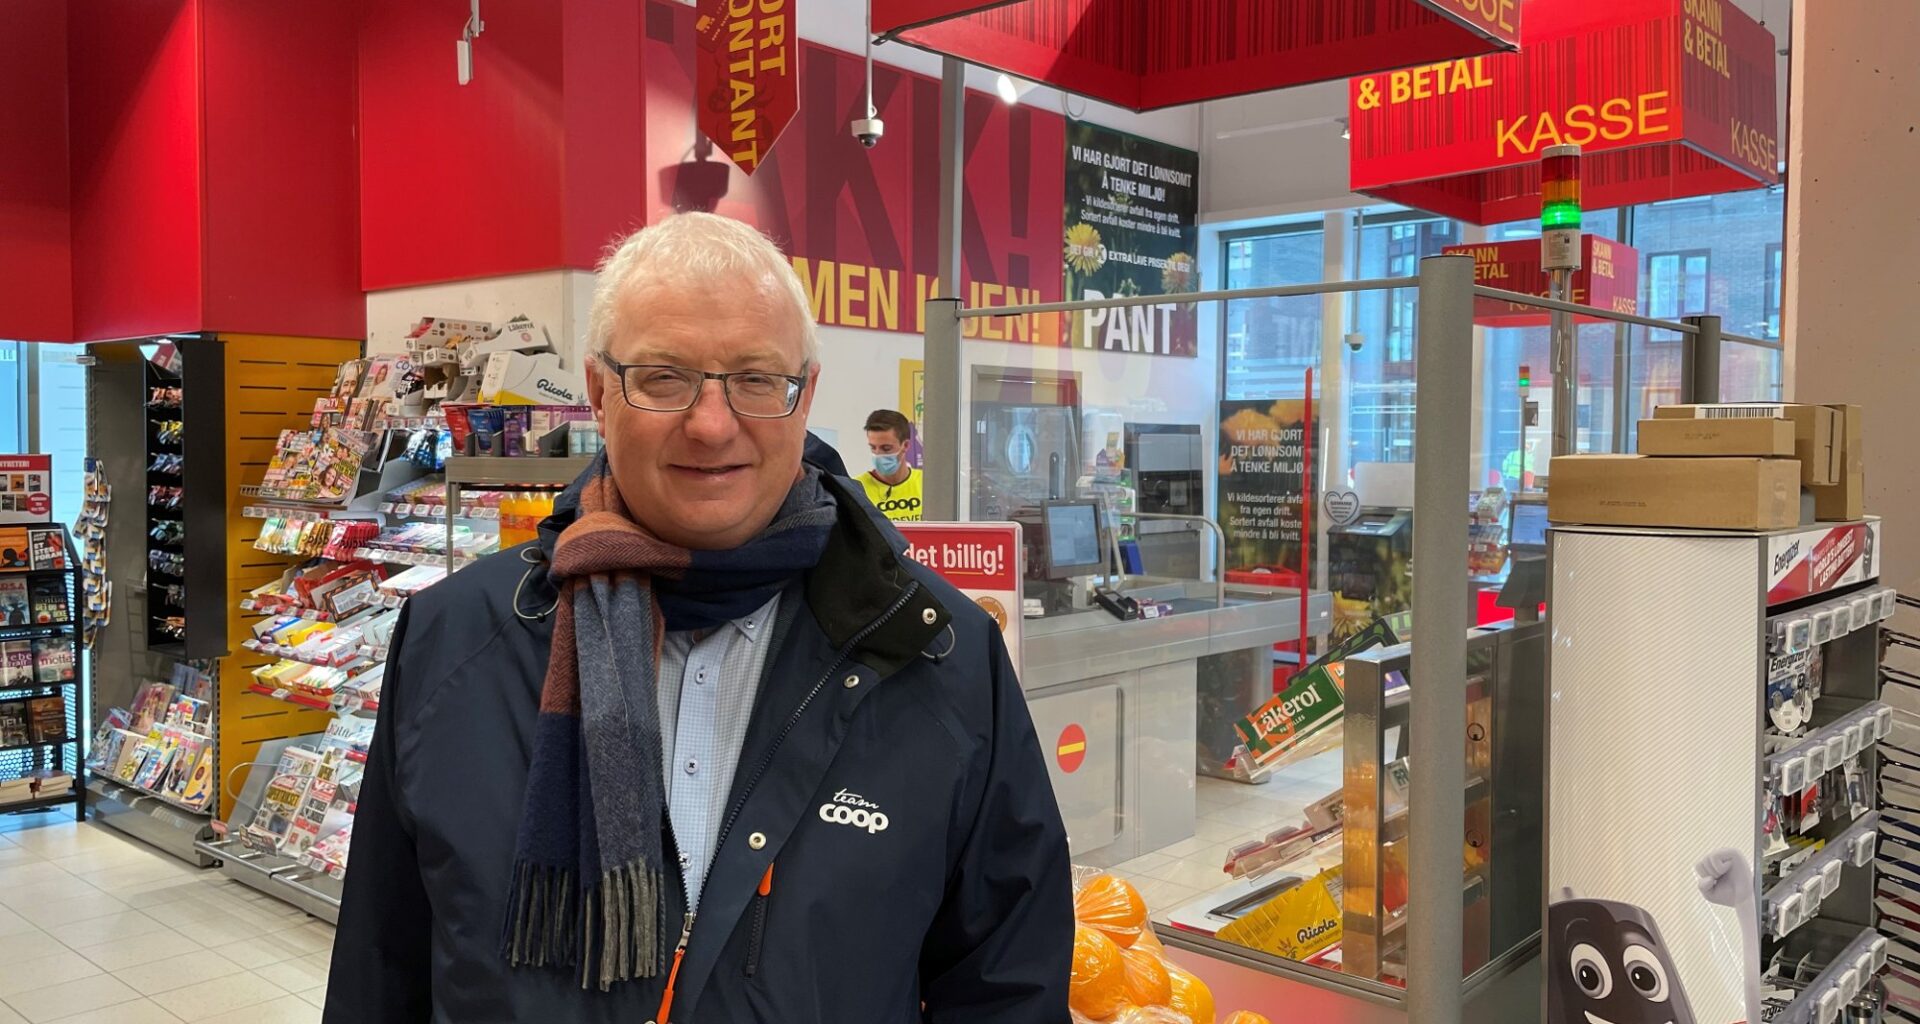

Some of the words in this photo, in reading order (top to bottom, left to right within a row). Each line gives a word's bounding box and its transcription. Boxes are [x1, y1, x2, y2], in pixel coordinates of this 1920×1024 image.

[1696, 26, 1730, 79] BETAL
[1357, 78, 1381, 110] &
[1391, 57, 1493, 104] BETAL
[1497, 91, 1669, 158] KASSE
[1731, 117, 1776, 175] KASSE
[1072, 145, 1081, 161] VI
[1083, 148, 1102, 166] HAR
[1103, 154, 1131, 173] GJORT
[1132, 160, 1148, 177] DET
[1149, 165, 1192, 187] LØNNSOMT
[1110, 177, 1137, 196] TENKE
[1108, 250, 1134, 264] EXTRA
[916, 273, 1040, 343] IJEN!
[1084, 289, 1176, 354] PANT
[537, 378, 573, 401] Ricola
[1236, 429, 1246, 441] VI
[1248, 429, 1268, 441] HAR
[1270, 429, 1303, 441] GJORT
[1231, 445, 1249, 457] DET
[1240, 461, 1271, 473] TENKE
[877, 497, 921, 512] coop
[1252, 507, 1272, 517] egen
[1229, 516, 1256, 527] Sortert
[1257, 517, 1279, 528] avfall
[1233, 528, 1260, 539] mindre
[943, 543, 1004, 576] billig!
[1773, 540, 1799, 576] Energizer
[1252, 683, 1322, 740] Läkerol
[833, 788, 879, 809] team
[819, 803, 889, 834] coop
[1297, 919, 1337, 944] Ricola
